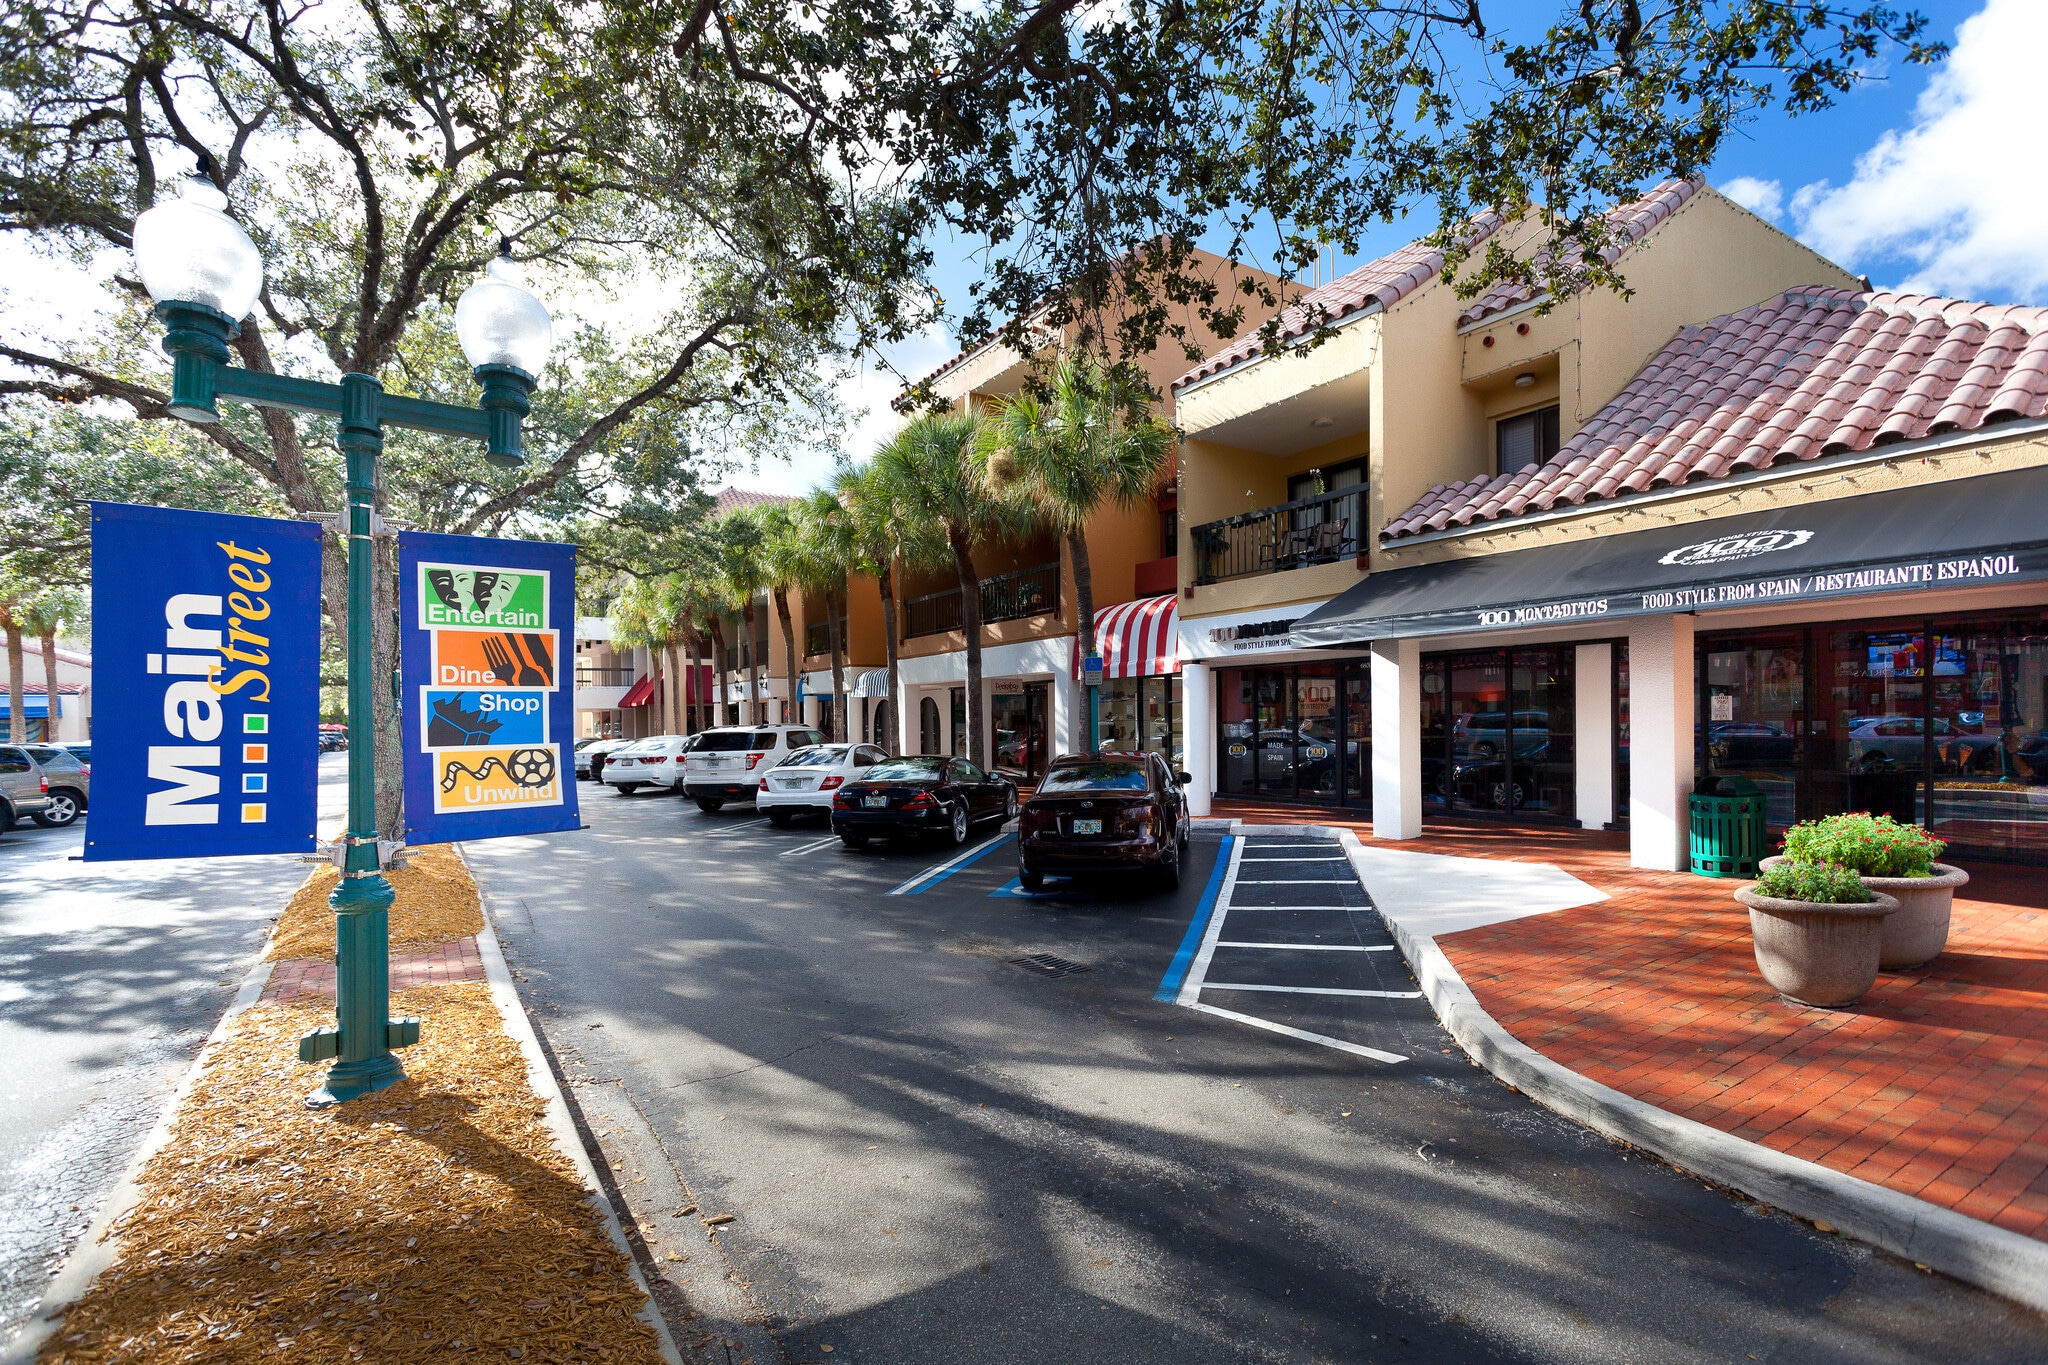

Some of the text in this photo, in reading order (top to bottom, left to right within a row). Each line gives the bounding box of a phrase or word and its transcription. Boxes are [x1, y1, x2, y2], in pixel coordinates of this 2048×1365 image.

[1692, 534, 1785, 556] 100
[1641, 593, 1673, 610] FOOD
[1676, 588, 1716, 607] STYLE
[1719, 582, 1756, 602] FROM
[1758, 577, 1801, 598] SPAIN
[1814, 563, 1933, 592] RESTAURANTE
[1937, 554, 2020, 580] ESPAÑOL
[207, 540, 272, 703] Street
[428, 603, 539, 626] Entertain
[1477, 598, 1608, 626] 100 MONTADITOS
[1208, 626, 1239, 642] 100
[1233, 643, 1248, 651] FOOD
[1247, 641, 1265, 650] STYLE
[1265, 640, 1280, 648] FROM
[441, 665, 496, 684] Dine
[145, 593, 223, 826] Main
[479, 693, 540, 715] Shop
[1310, 747, 1324, 755] 100
[464, 781, 553, 804] Unwind
